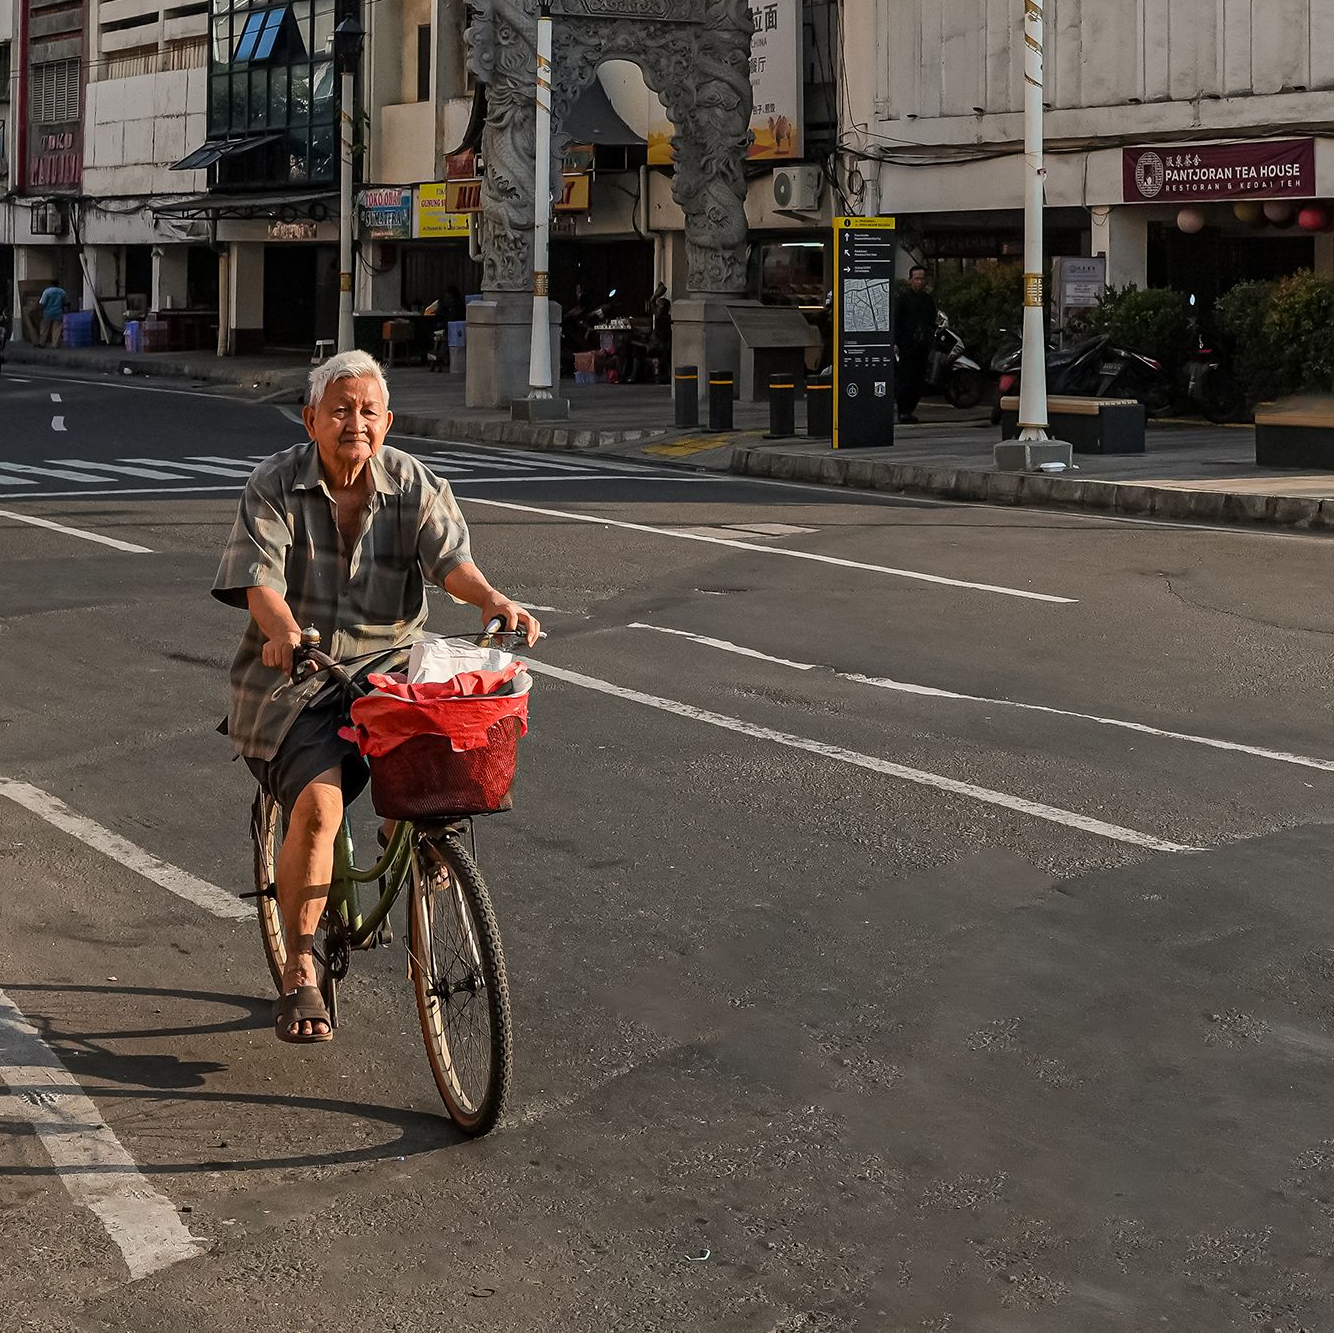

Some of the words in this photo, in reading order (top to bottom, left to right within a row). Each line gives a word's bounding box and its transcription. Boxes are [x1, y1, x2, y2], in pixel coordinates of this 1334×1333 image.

[1166, 168, 1232, 181] PANTJORAN
[1235, 166, 1257, 179] TEA
[1260, 163, 1301, 178] HOUSE
[1165, 182, 1220, 192] RESTORAN
[1280, 179, 1301, 188] TEH
